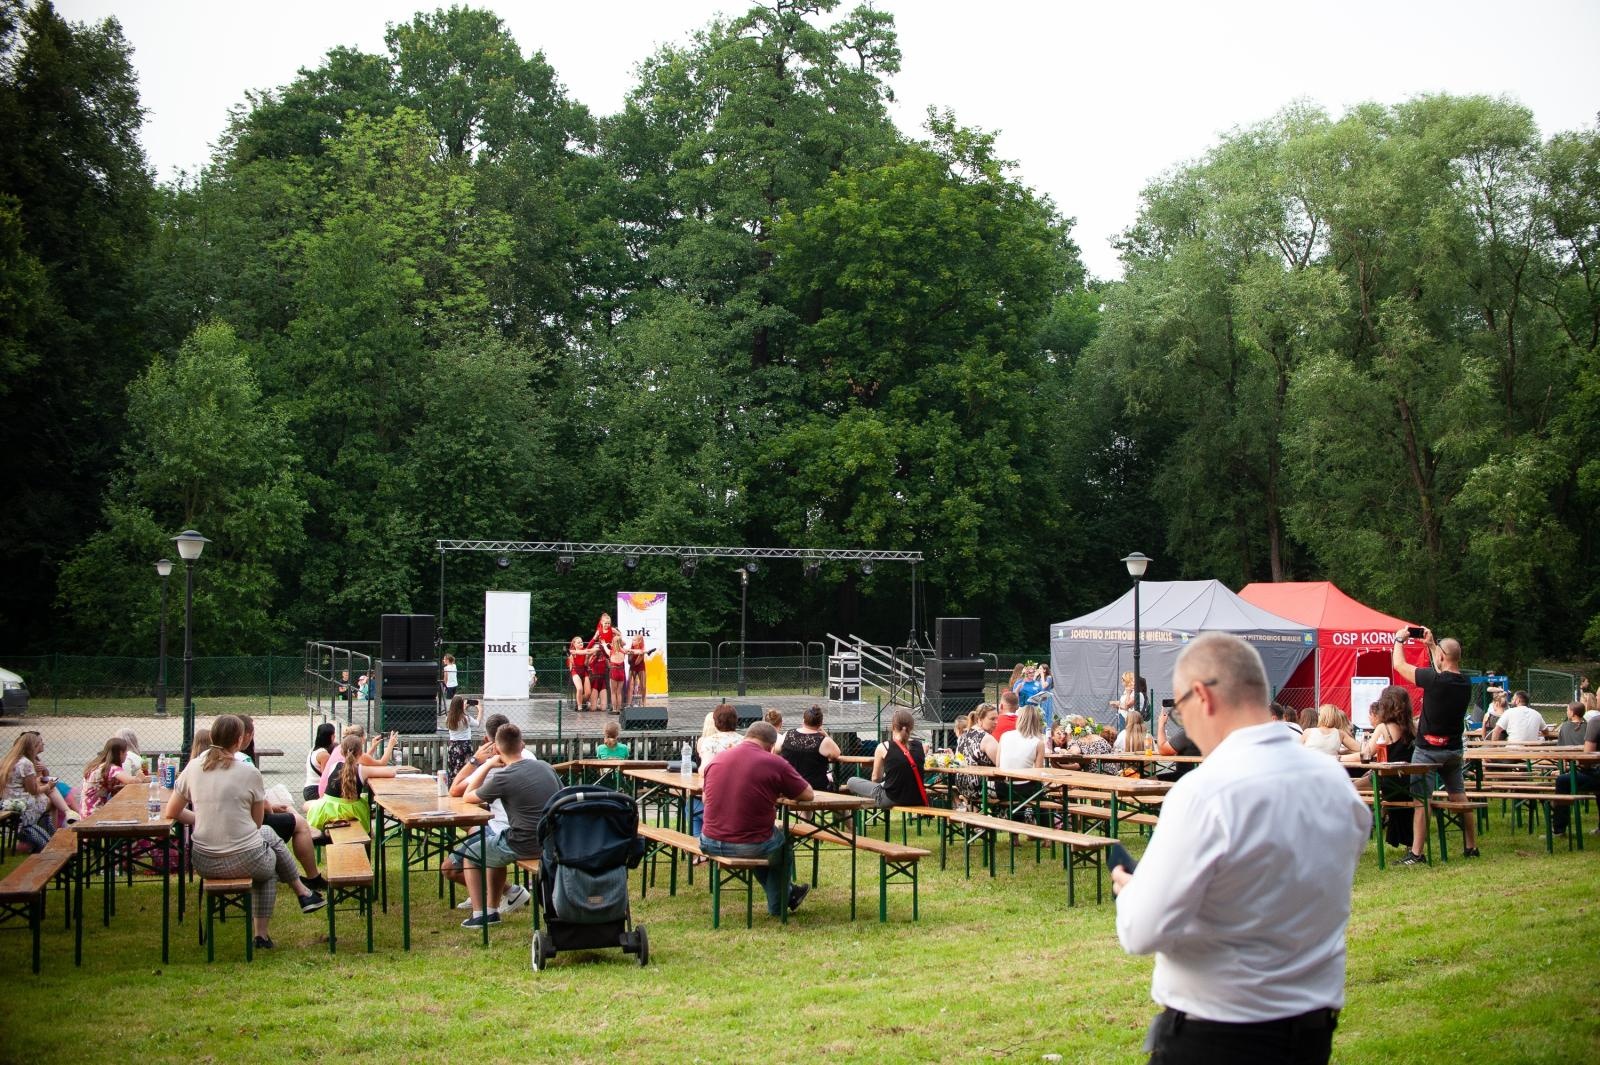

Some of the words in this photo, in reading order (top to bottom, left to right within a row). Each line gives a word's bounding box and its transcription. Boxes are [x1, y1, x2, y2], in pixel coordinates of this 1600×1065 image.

[626, 627, 650, 637] mdk
[1146, 630, 1173, 642] WIELKIE
[1332, 632, 1358, 645] OSP
[487, 641, 517, 653] mdk
